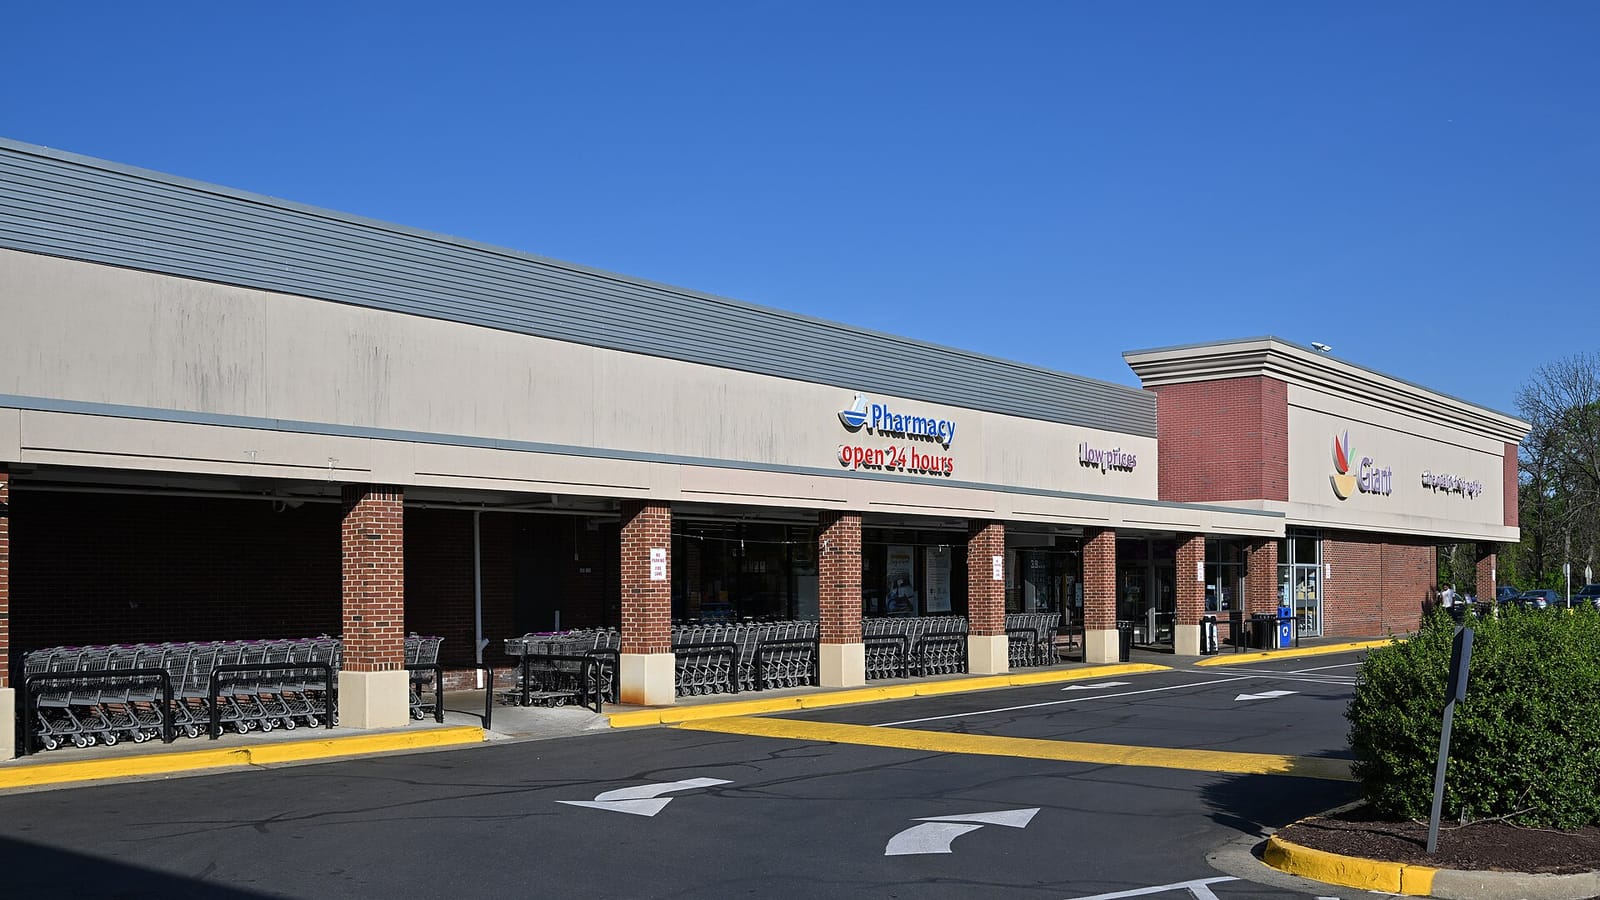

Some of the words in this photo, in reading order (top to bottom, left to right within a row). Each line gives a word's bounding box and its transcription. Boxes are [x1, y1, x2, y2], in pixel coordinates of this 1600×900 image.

[871, 403, 956, 445] Pharmacy
[841, 445, 885, 471] open
[887, 445, 907, 468] 24
[911, 445, 955, 474] hours
[1084, 441, 1104, 463] low
[1105, 449, 1137, 470] prices
[1359, 456, 1393, 494] Giant
